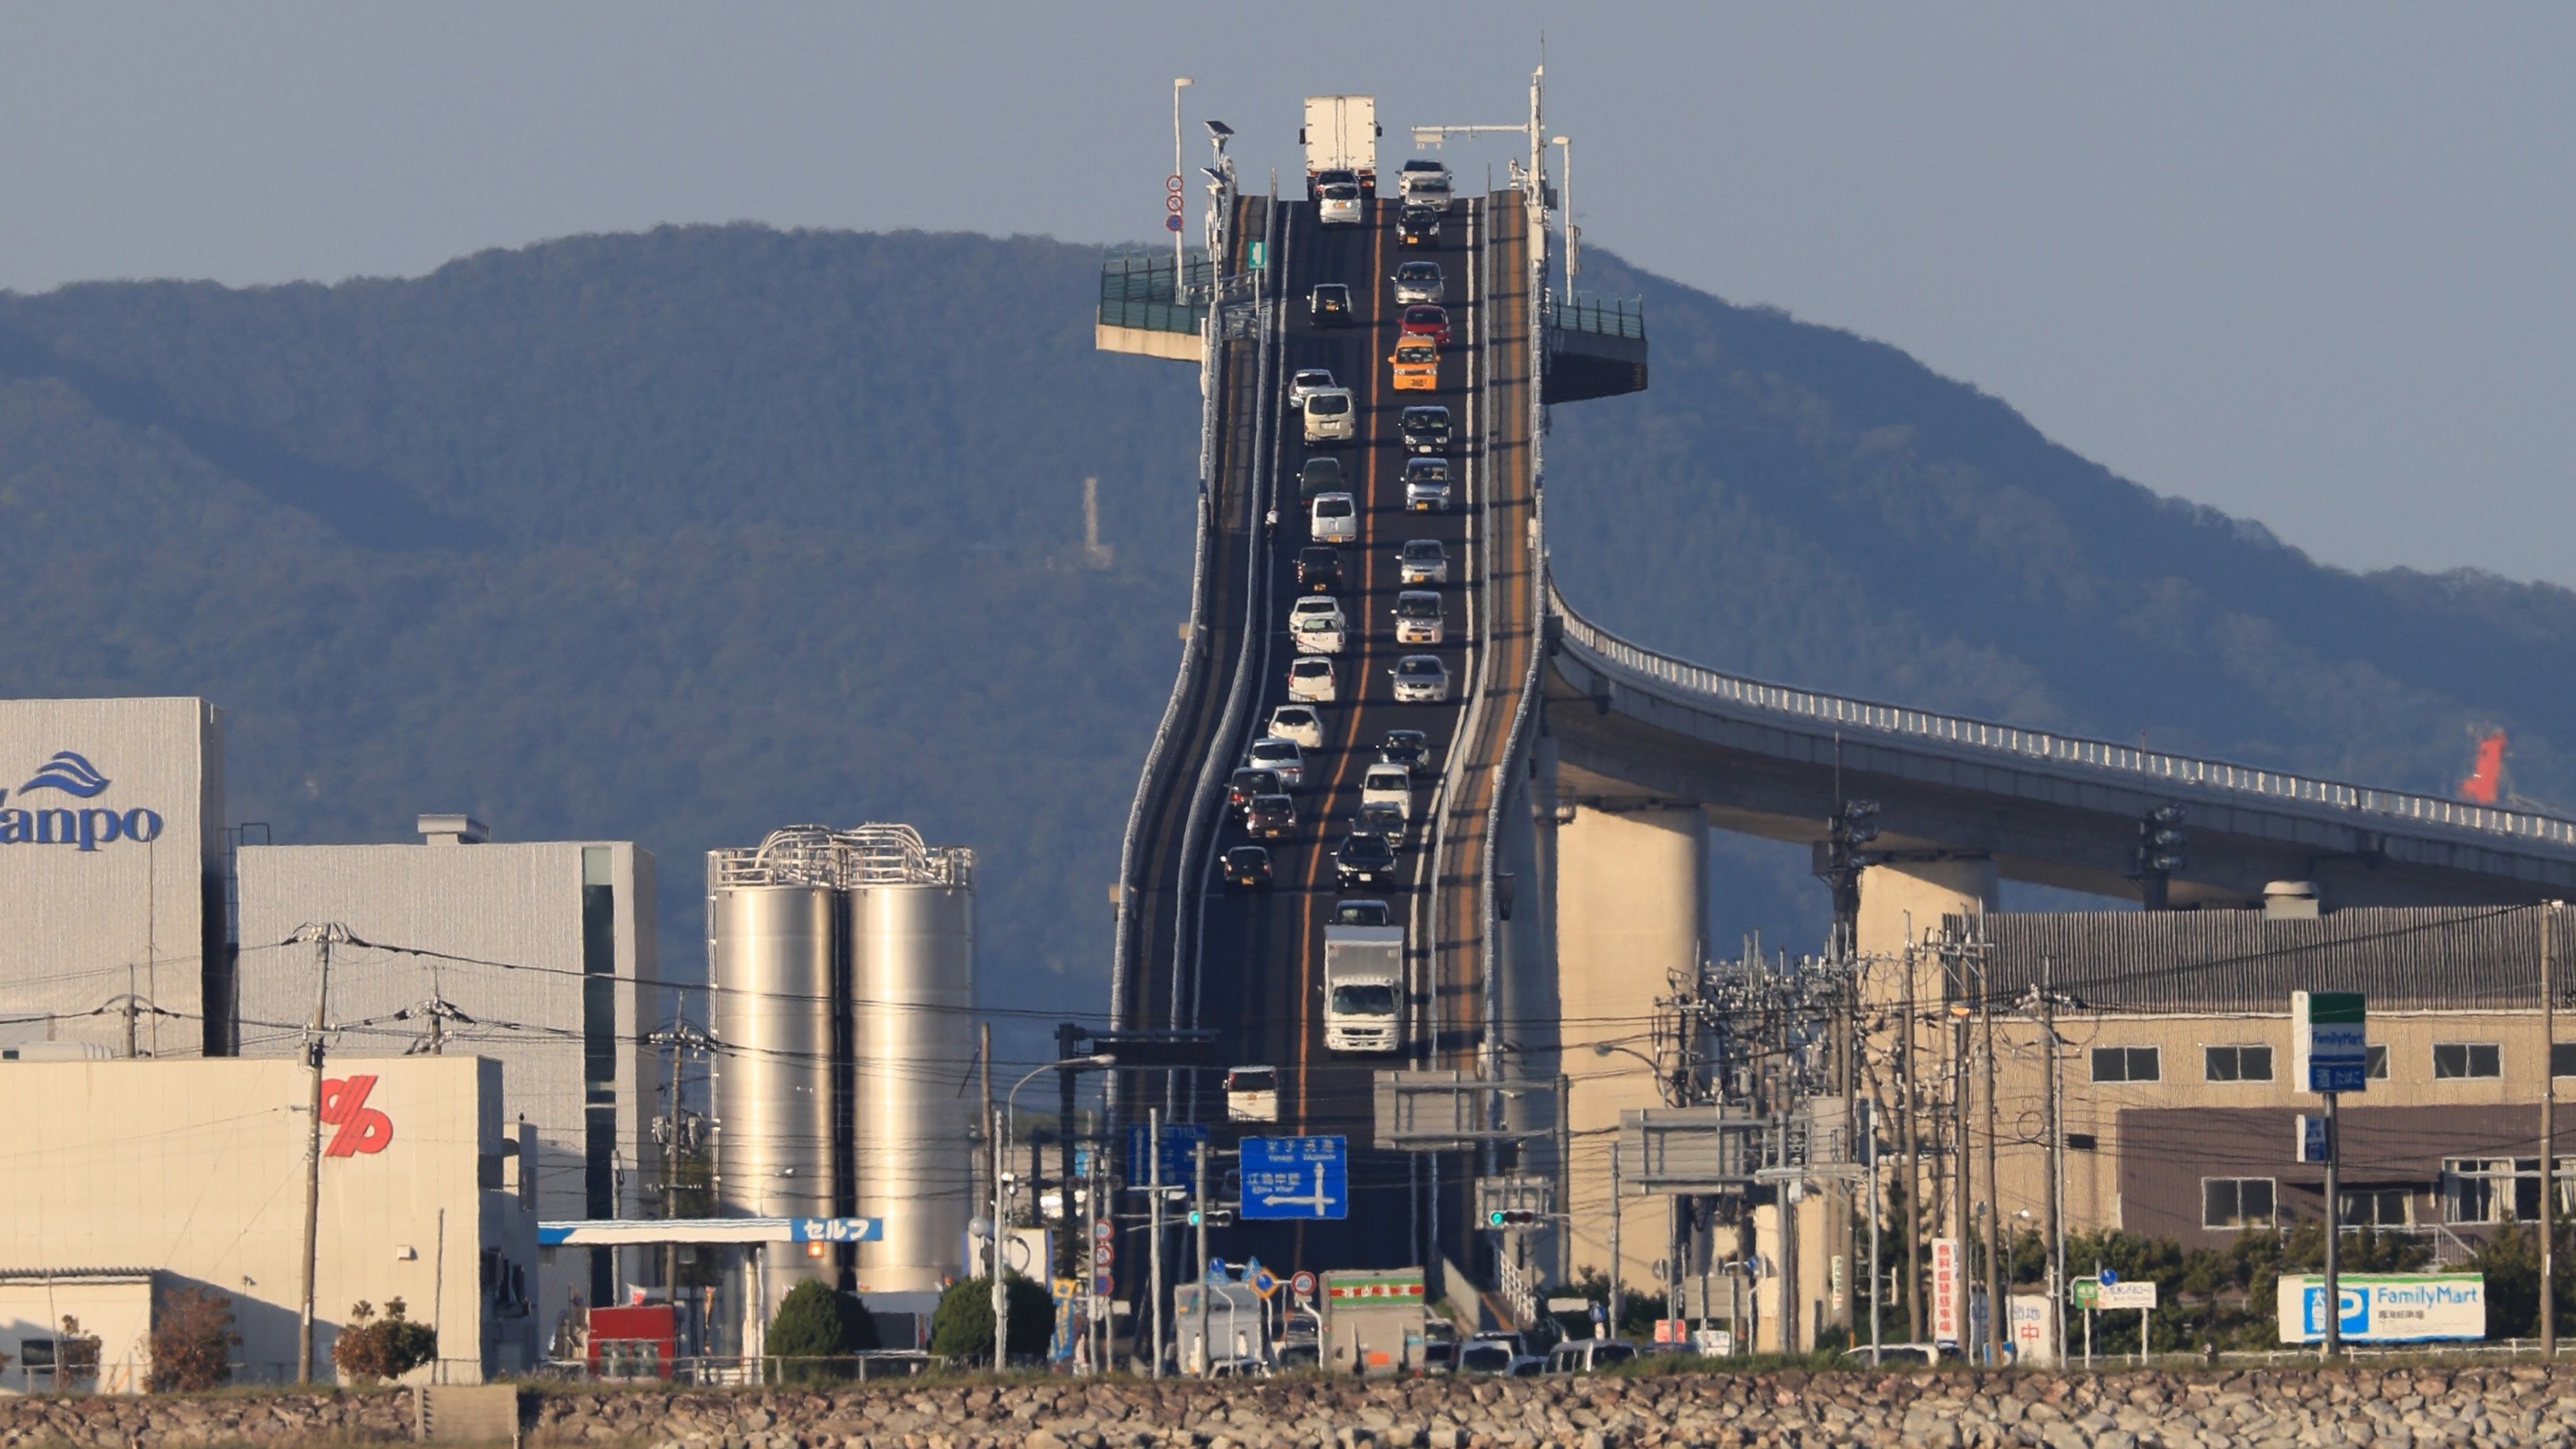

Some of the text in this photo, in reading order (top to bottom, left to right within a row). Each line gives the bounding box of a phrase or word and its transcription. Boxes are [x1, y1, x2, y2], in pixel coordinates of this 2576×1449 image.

[0, 788, 163, 851] anpo
[2312, 1032, 2363, 1047] FamilyMart
[804, 1218, 869, 1240] セルフ
[2377, 1286, 2477, 1308] FamilyMart
